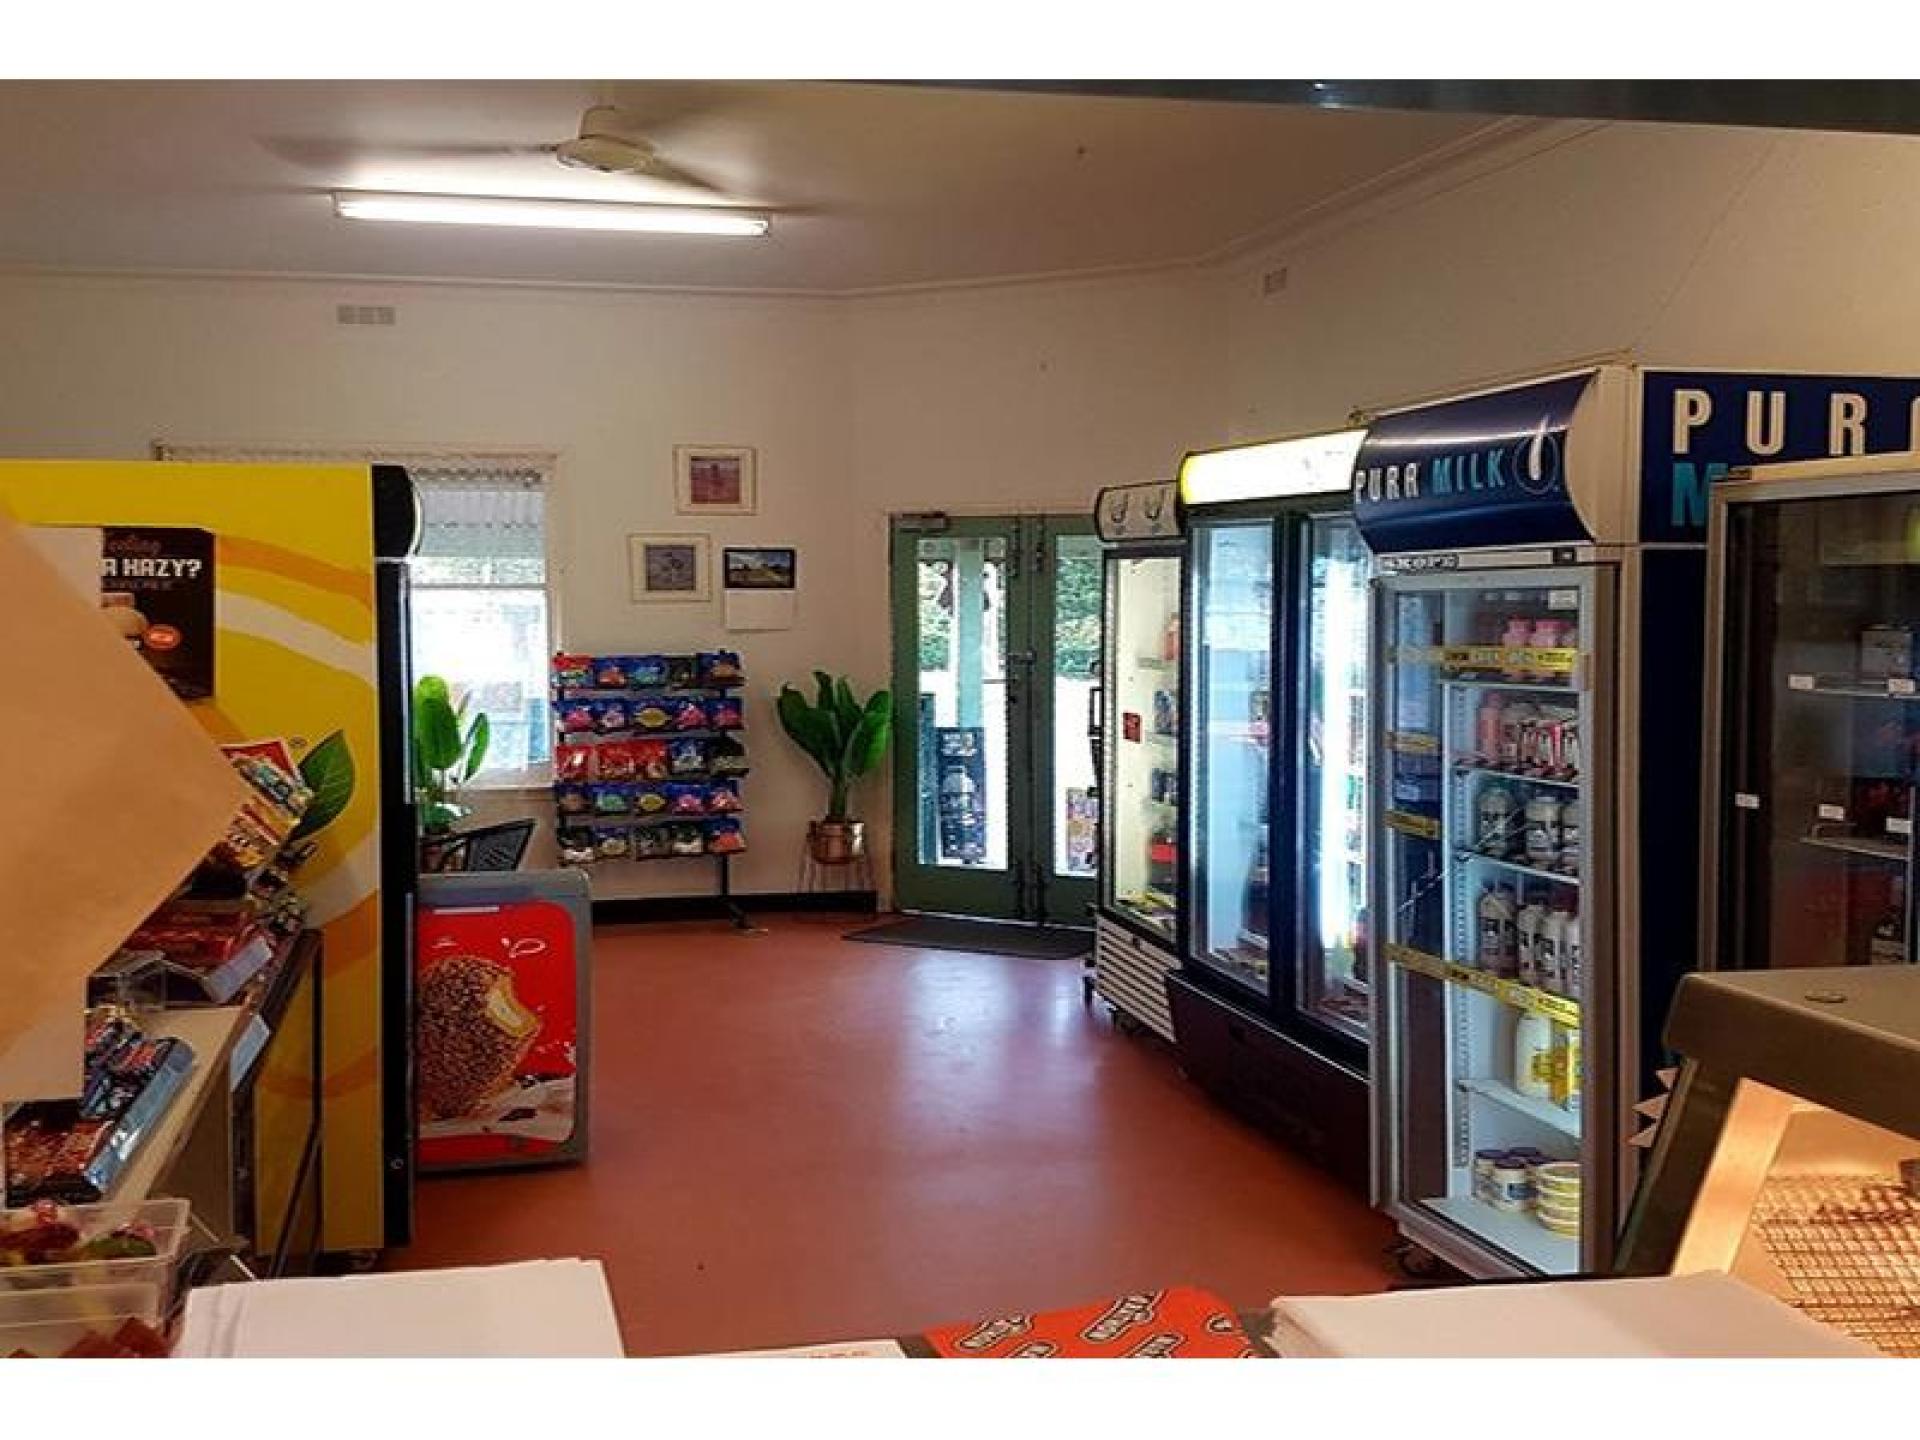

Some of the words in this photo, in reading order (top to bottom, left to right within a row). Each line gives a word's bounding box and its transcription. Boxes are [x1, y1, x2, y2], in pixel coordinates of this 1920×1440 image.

[1673, 388, 1920, 456] PUR
[1433, 448, 1505, 495] MILK
[123, 558, 202, 578] HAZY?
